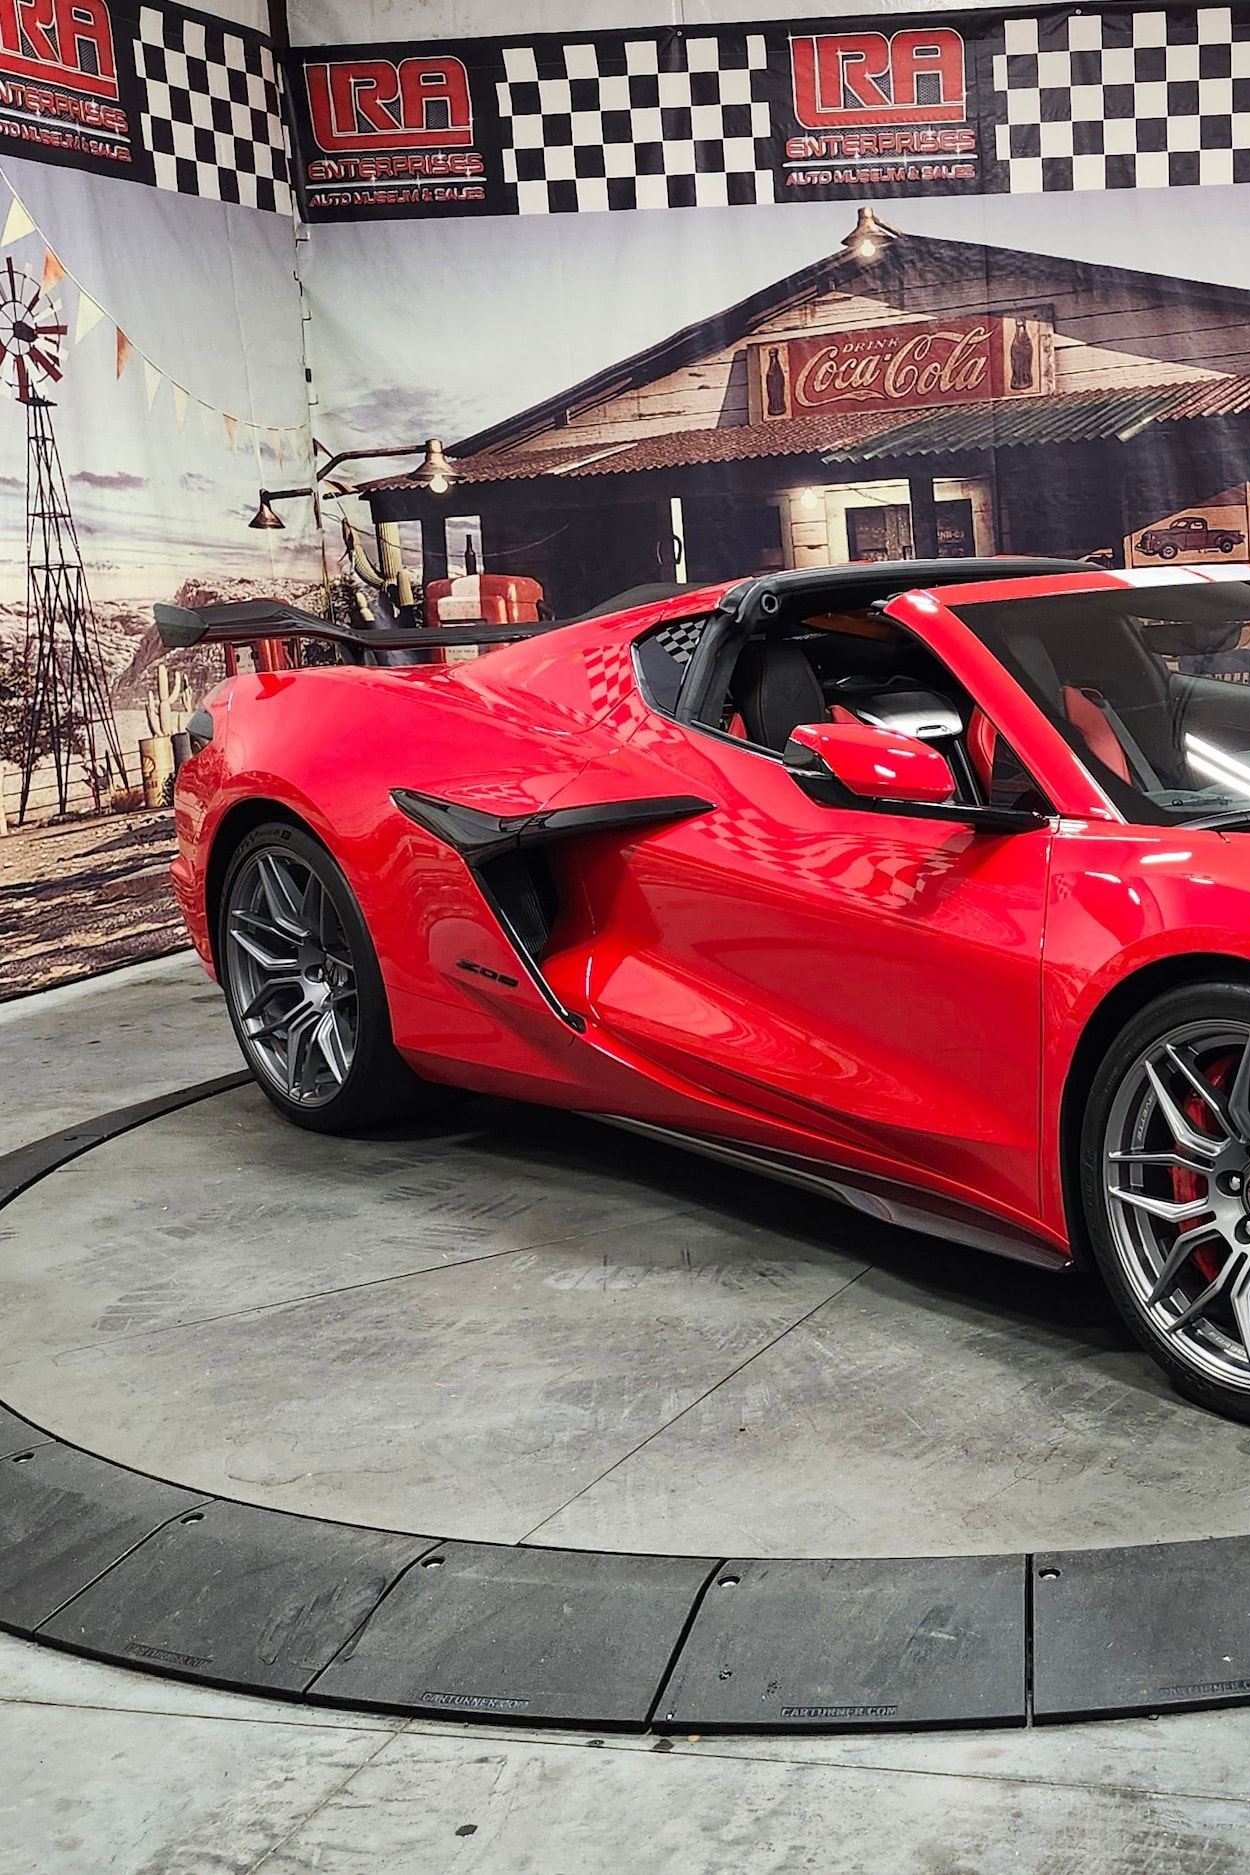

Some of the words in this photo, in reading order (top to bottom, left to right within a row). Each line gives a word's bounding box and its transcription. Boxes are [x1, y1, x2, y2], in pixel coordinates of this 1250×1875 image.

[0, 80, 129, 134] NTERPRISES
[21, 123, 81, 151] MUSEUM
[89, 139, 133, 163] SALES
[785, 128, 976, 159] ENTERPRISES
[307, 152, 485, 181] ENTERPRISES
[785, 171, 833, 187] AUTO
[833, 167, 906, 184] MUSEUM
[907, 166, 920, 181] &
[921, 164, 976, 180] SALES
[309, 193, 352, 208] AUTO
[353, 189, 420, 205] MUSEUM
[421, 187, 433, 202] &
[434, 186, 486, 201] SALES
[842, 336, 901, 354] DRINK
